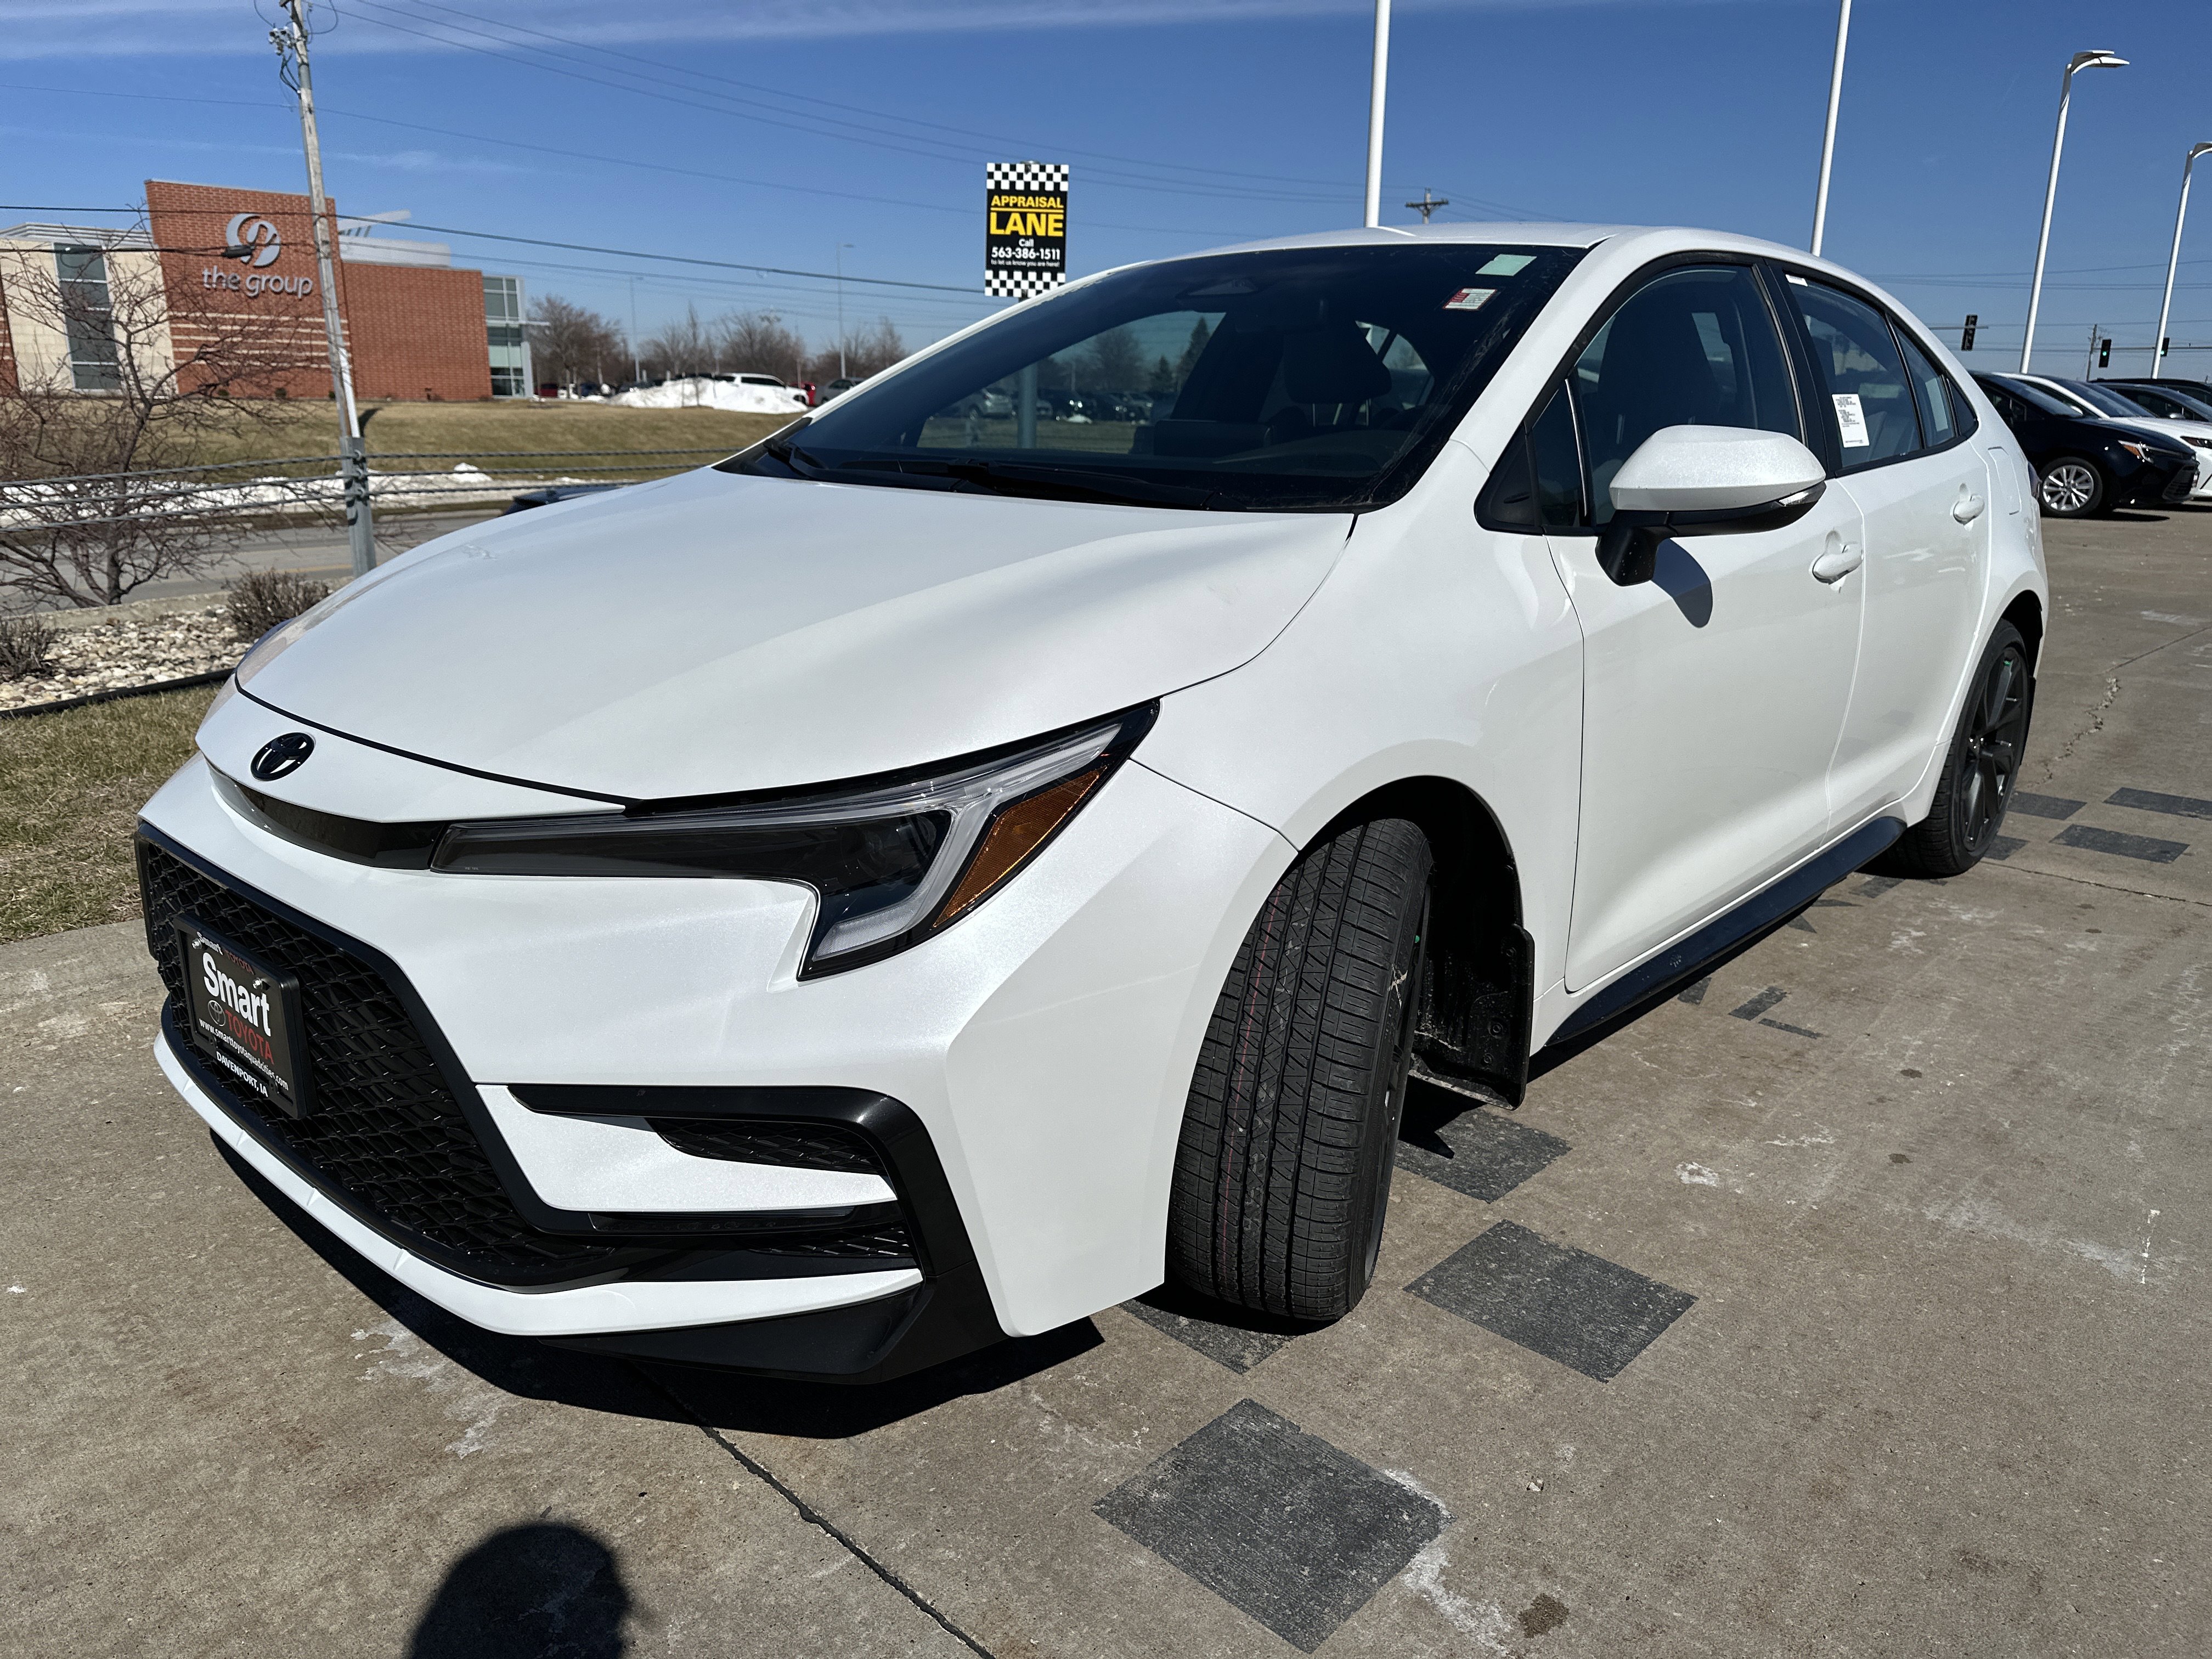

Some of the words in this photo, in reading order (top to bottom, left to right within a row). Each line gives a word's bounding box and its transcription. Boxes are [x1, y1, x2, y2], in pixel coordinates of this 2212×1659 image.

[991, 195, 1064, 208] APPRAISAL
[990, 212, 1063, 237] LANE
[991, 246, 1060, 260] 563-386-1511
[1018, 238, 1034, 247] Call
[202, 265, 240, 290] the
[246, 274, 313, 299] group
[197, 932, 223, 956] Smart
[203, 952, 272, 1037] Smart
[225, 1009, 274, 1065] TOYOTA
[199, 1018, 289, 1091] www.smarttoyotaquadcities.com
[259, 1082, 268, 1097] IA
